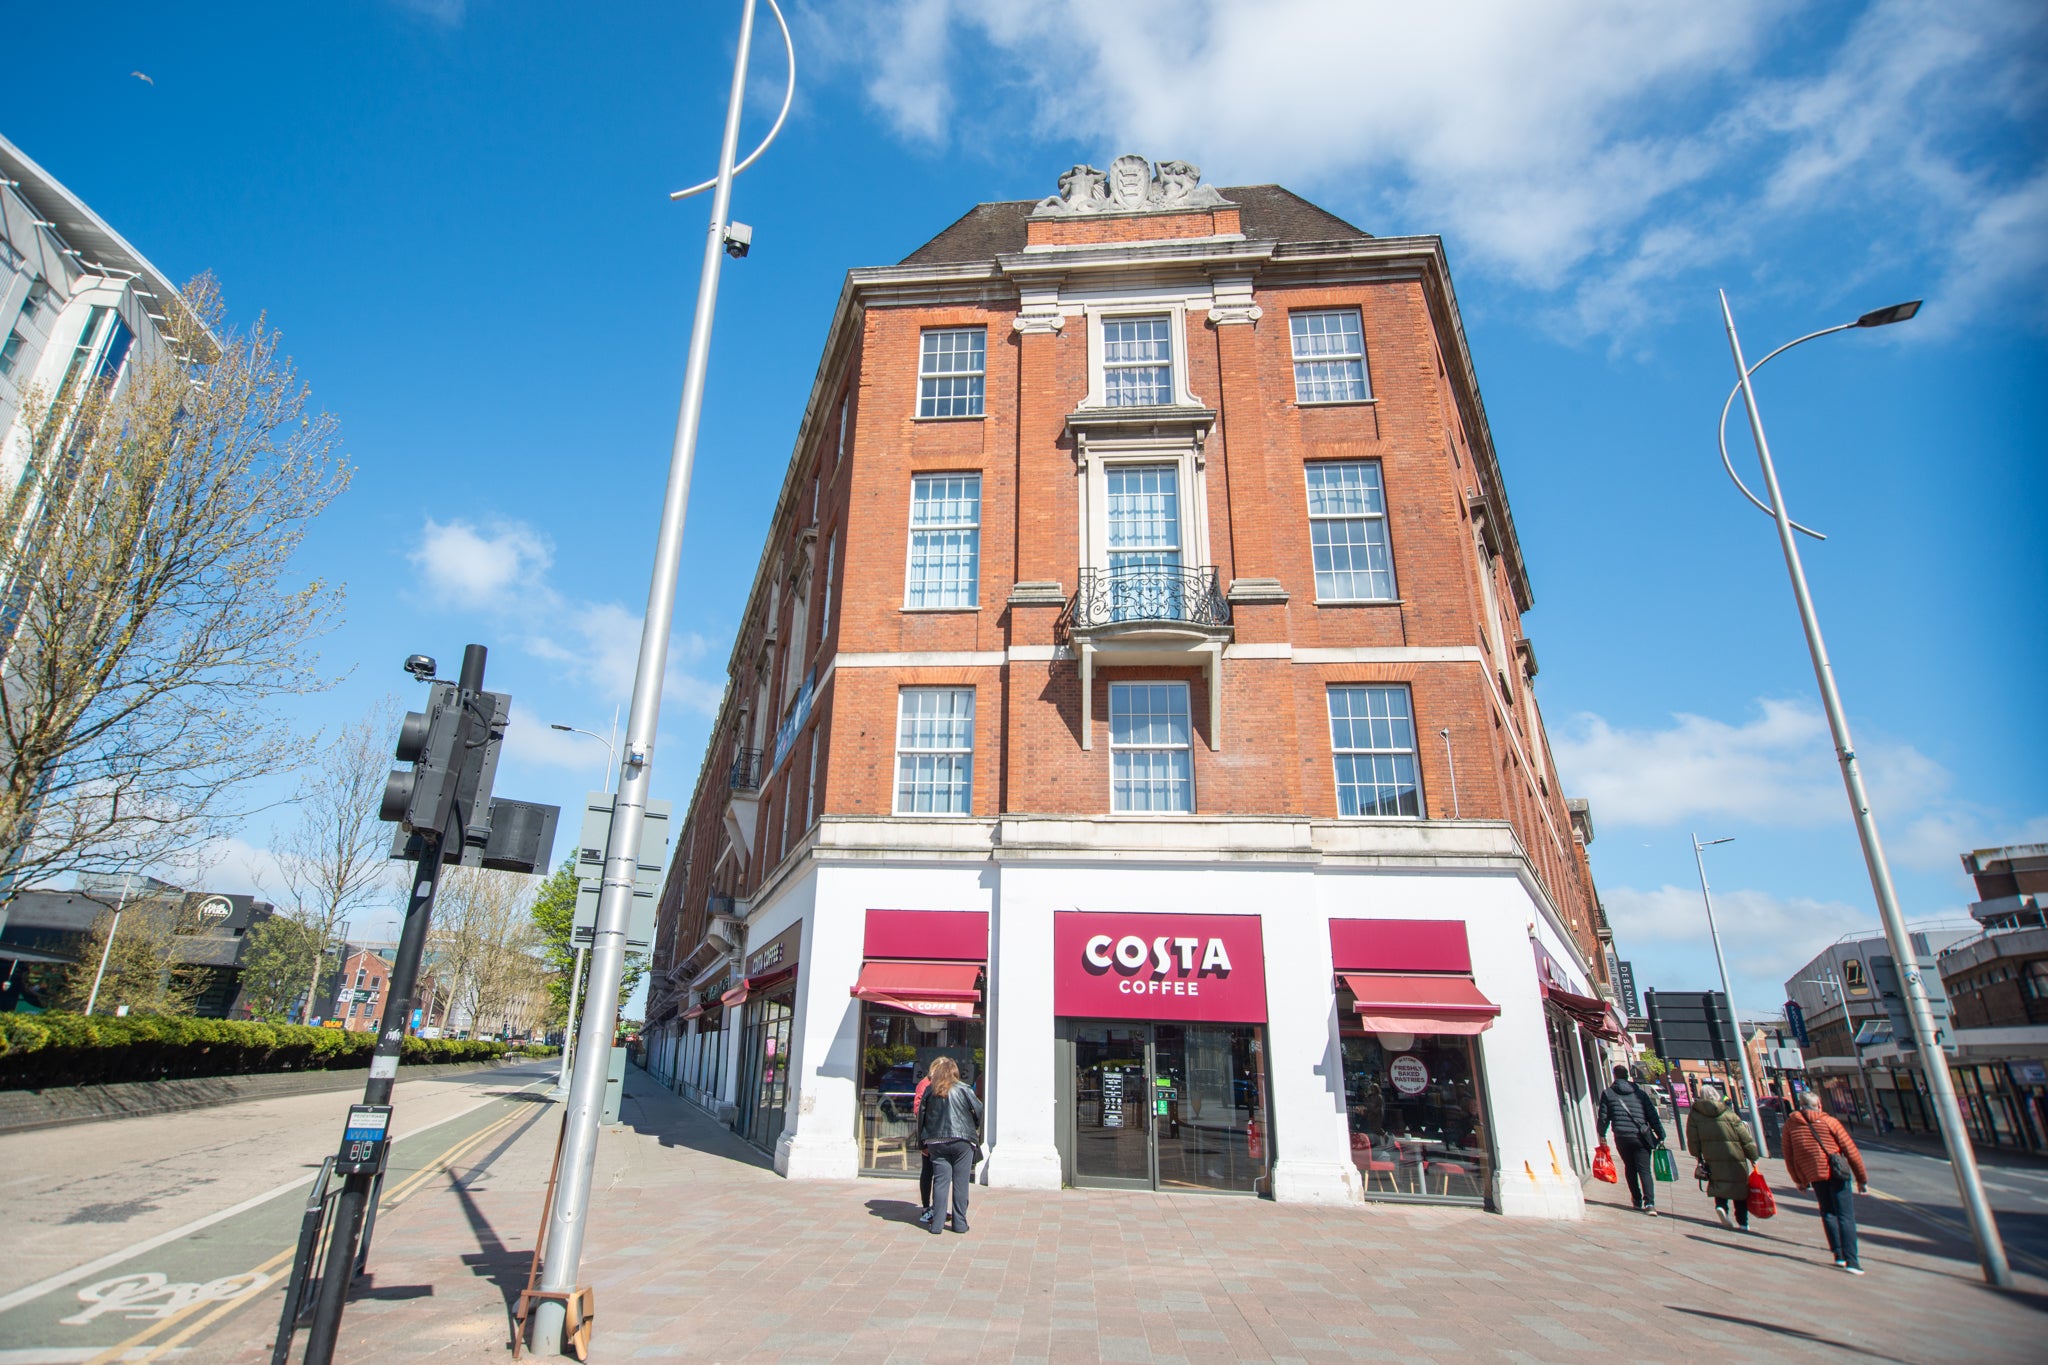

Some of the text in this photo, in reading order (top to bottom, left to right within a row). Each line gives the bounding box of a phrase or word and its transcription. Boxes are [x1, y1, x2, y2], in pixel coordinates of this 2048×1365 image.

[1085, 934, 1233, 975] COSTA
[1118, 979, 1199, 996] COFFEE
[917, 1002, 957, 1011] COFFEE
[350, 1129, 380, 1140] WAIT
